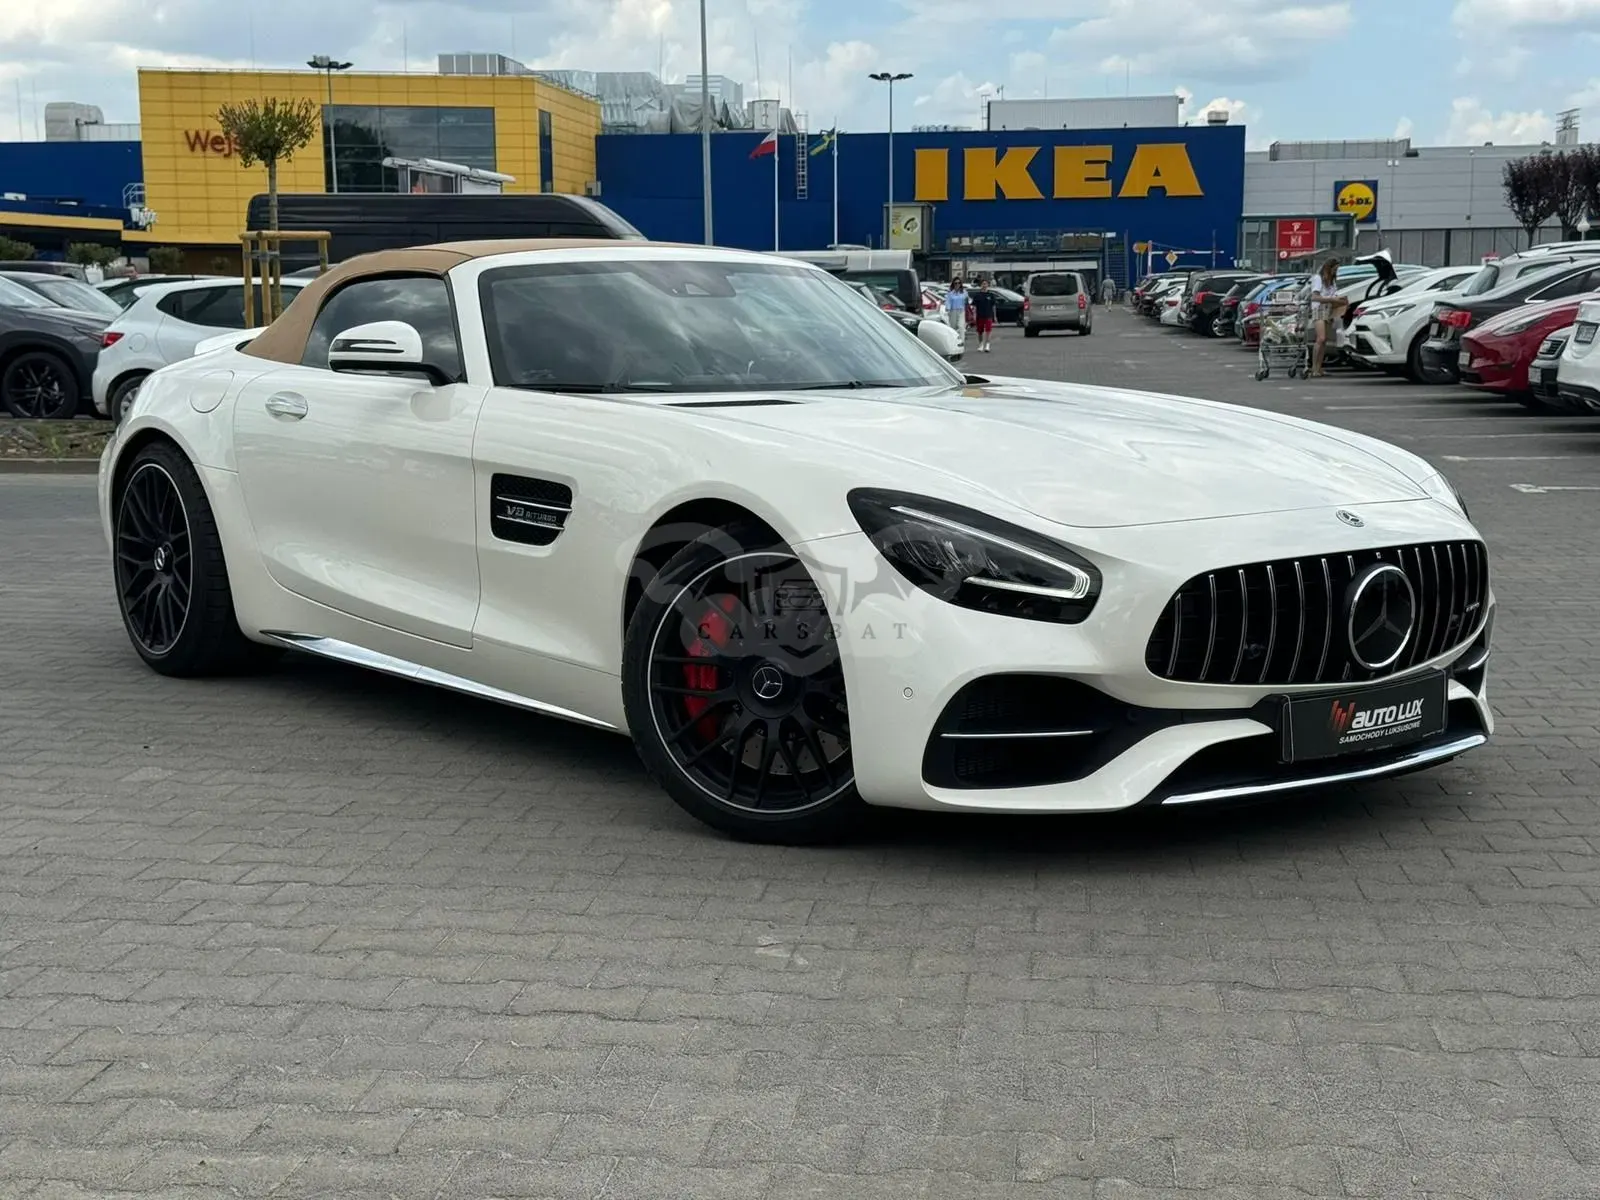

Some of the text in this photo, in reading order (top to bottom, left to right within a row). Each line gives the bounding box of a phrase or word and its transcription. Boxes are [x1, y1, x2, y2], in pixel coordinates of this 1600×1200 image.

[914, 142, 1205, 201] IKEA
[1397, 698, 1425, 721] LUX
[1338, 729, 1385, 745] SAMOCHODY
[1384, 720, 1422, 737] LUKSUSOWE
